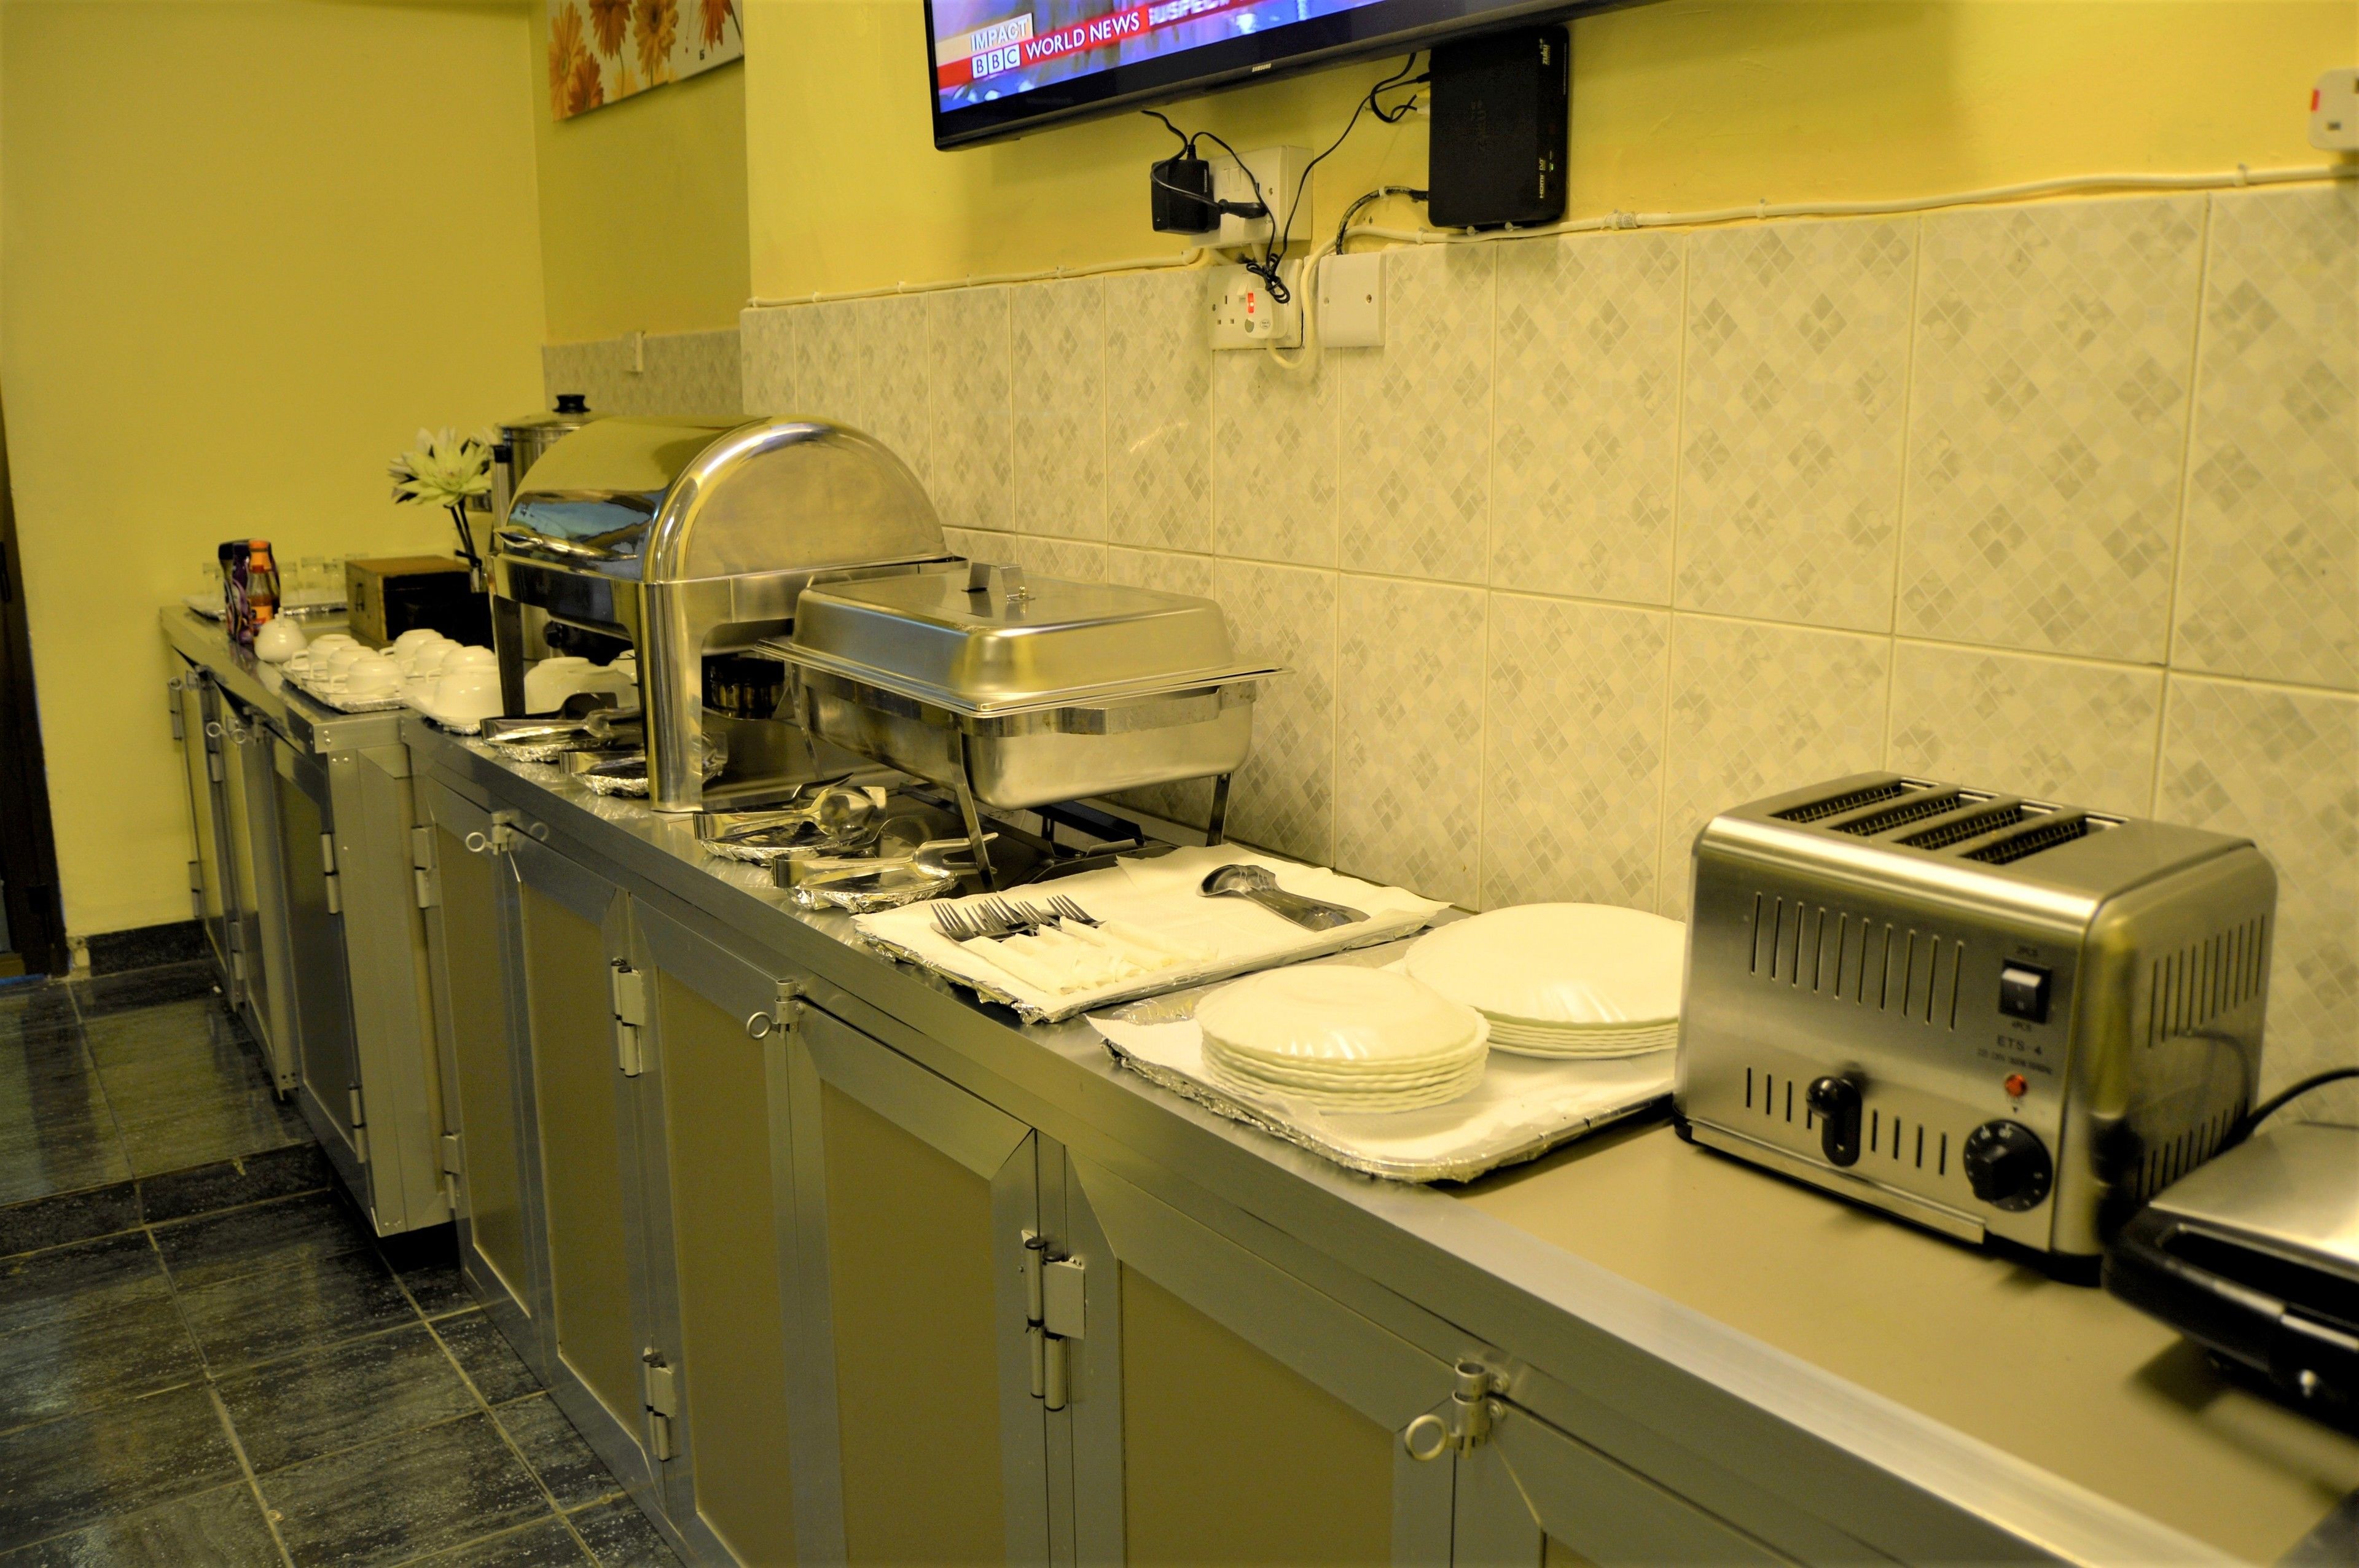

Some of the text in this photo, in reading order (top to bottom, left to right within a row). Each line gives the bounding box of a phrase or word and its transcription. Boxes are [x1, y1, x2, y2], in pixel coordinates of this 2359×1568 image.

[971, 18, 1028, 52] IMPACT
[974, 12, 1140, 77] BBC WORLD NEWS
[1252, 63, 1272, 72] SAMSUNG
